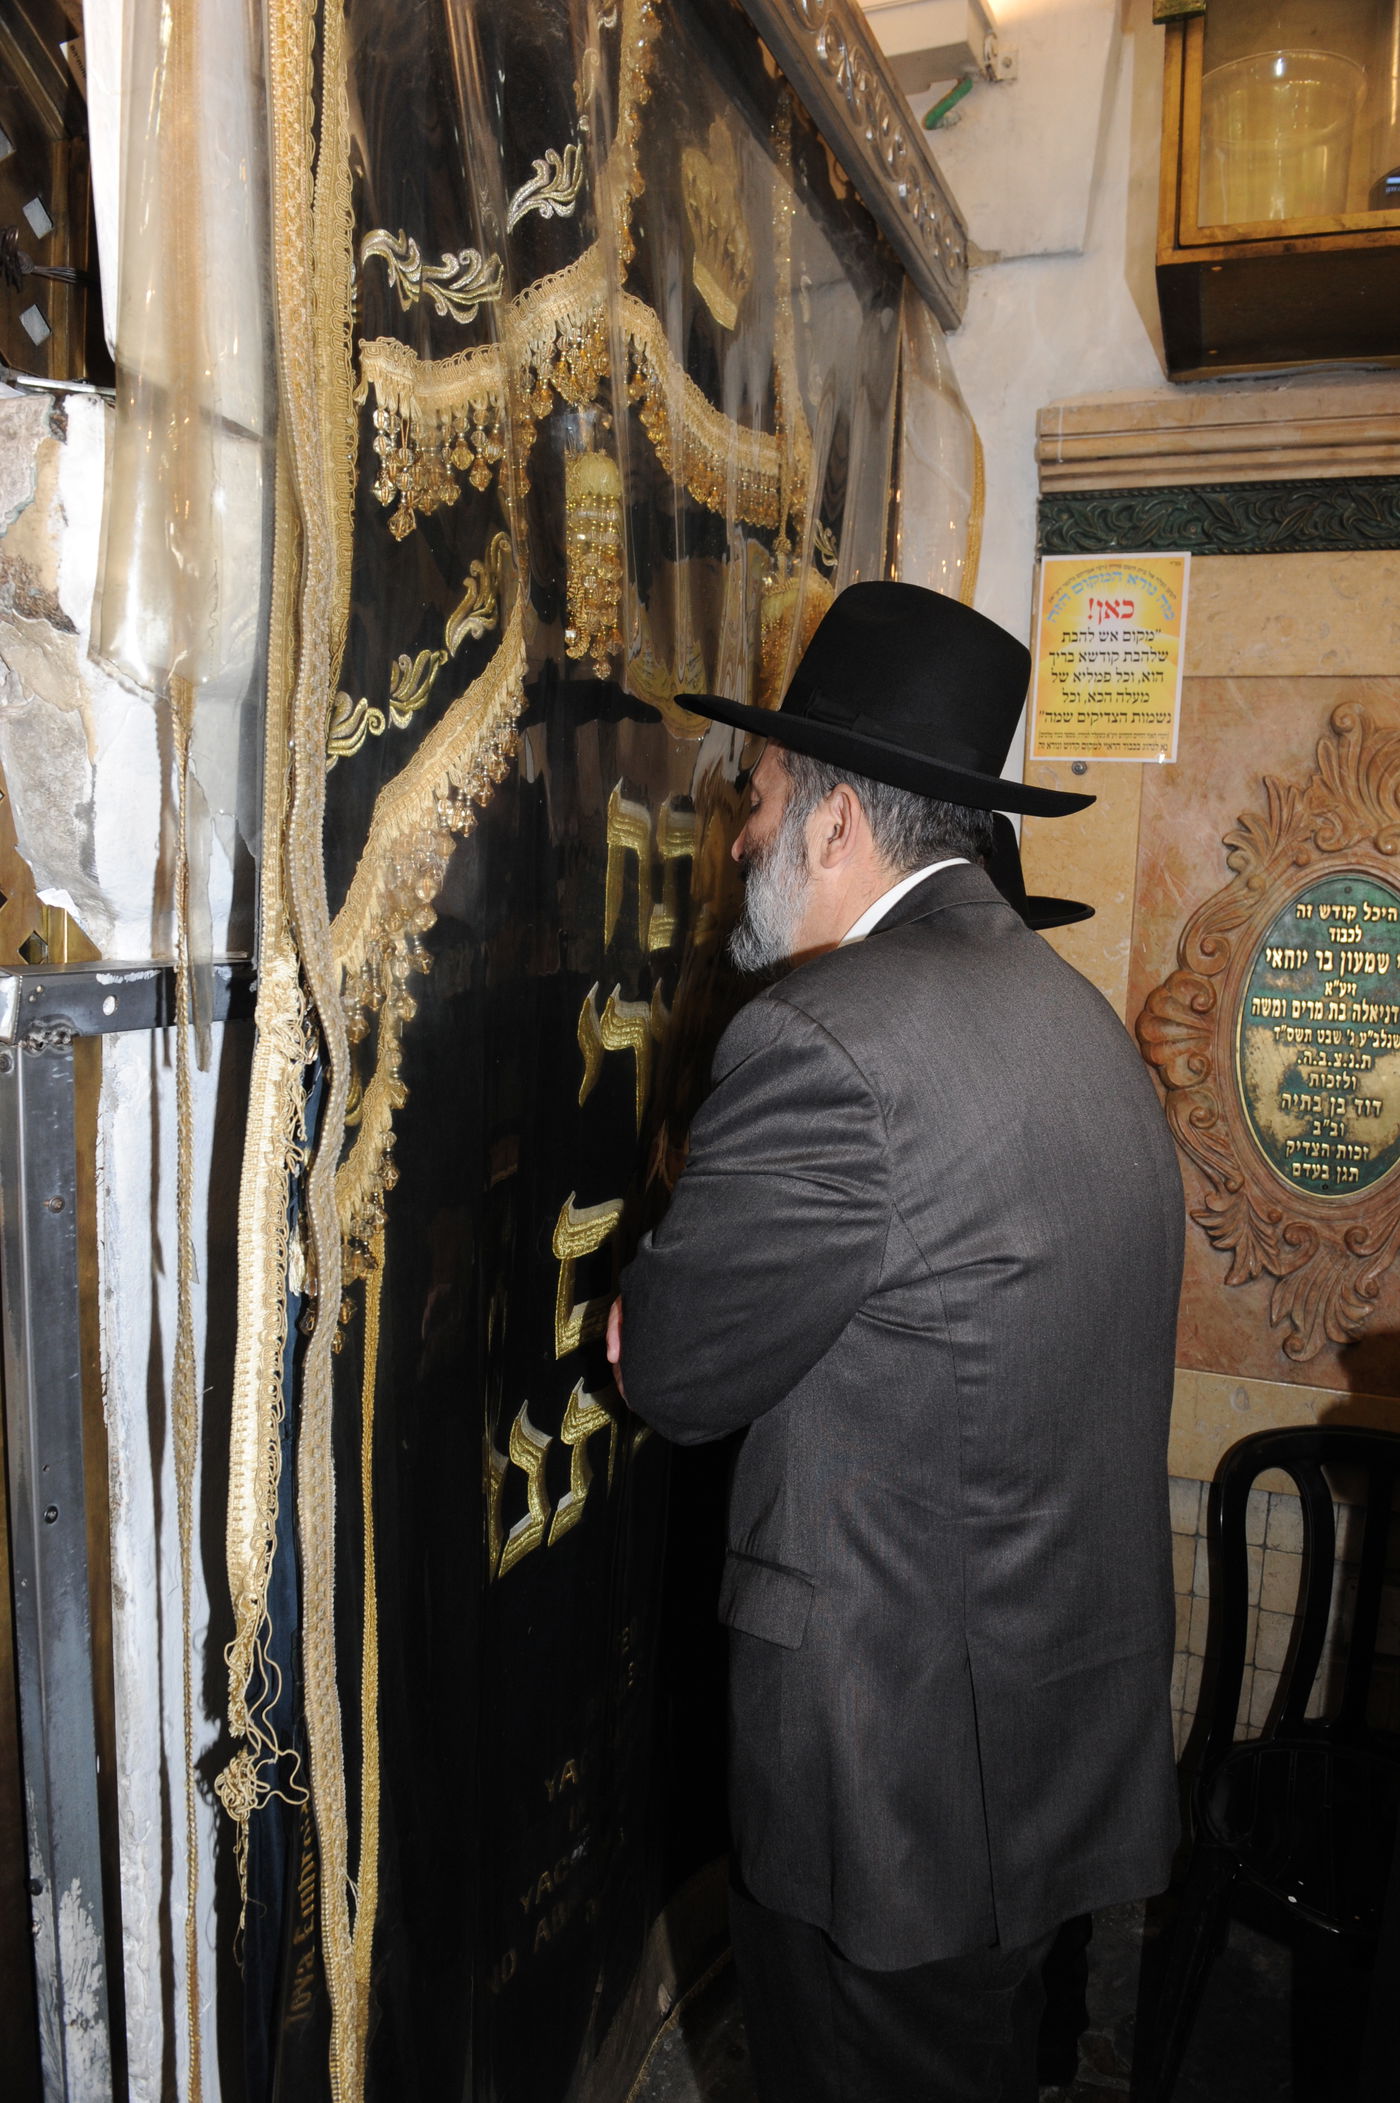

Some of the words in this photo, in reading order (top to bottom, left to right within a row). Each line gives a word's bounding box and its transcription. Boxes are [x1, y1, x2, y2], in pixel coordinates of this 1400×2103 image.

[1071, 571, 1122, 594] המקום
[1127, 573, 1158, 596] נורא
[1047, 592, 1071, 623] הזה
[1088, 598, 1134, 624] כאן!
[1156, 594, 1174, 621] מה
[1062, 627, 1094, 643] להבת
[1099, 631, 1118, 642] אש
[1049, 651, 1074, 665] בריך
[1078, 651, 1120, 665] קודשא
[1123, 646, 1168, 663] שלהבת
[1052, 668, 1069, 683] של
[1073, 668, 1111, 683] פמליא
[1116, 668, 1134, 683] וכל
[1138, 671, 1164, 683] הוא,
[1062, 688, 1080, 703] וכל
[1116, 688, 1150, 704] מעלה
[1078, 712, 1128, 726] הצדיקים
[1132, 712, 1172, 724] נשמות
[1296, 903, 1313, 919] זה
[1319, 903, 1357, 924] קודש
[1363, 900, 1399, 922] היכל
[1328, 924, 1362, 943] לכבוד
[1266, 947, 1308, 970] יוחאי
[1315, 950, 1334, 971] בר
[1340, 950, 1390, 977] שמעון
[1324, 980, 1357, 998] זיע"א
[1252, 997, 1286, 1018] ומשה
[1292, 999, 1324, 1020] מרים
[1328, 1001, 1346, 1022] בת
[1352, 998, 1400, 1024] דניאלה
[1274, 1025, 1312, 1044] תשס"ד
[1317, 1029, 1342, 1045] שבט
[1298, 1050, 1372, 1070] ת.נ.צ.ב.ה.
[1309, 1071, 1357, 1090] ולזכות
[1282, 1093, 1322, 1112] בתיה
[1330, 1097, 1346, 1118] בן
[1354, 1098, 1383, 1116] דוד
[1313, 1119, 1344, 1136] וב"ב
[1286, 1140, 1330, 1158] הצדיק
[1336, 1144, 1370, 1160] זכות
[1292, 1162, 1330, 1180] בעדם
[1336, 1165, 1359, 1184] תגן
